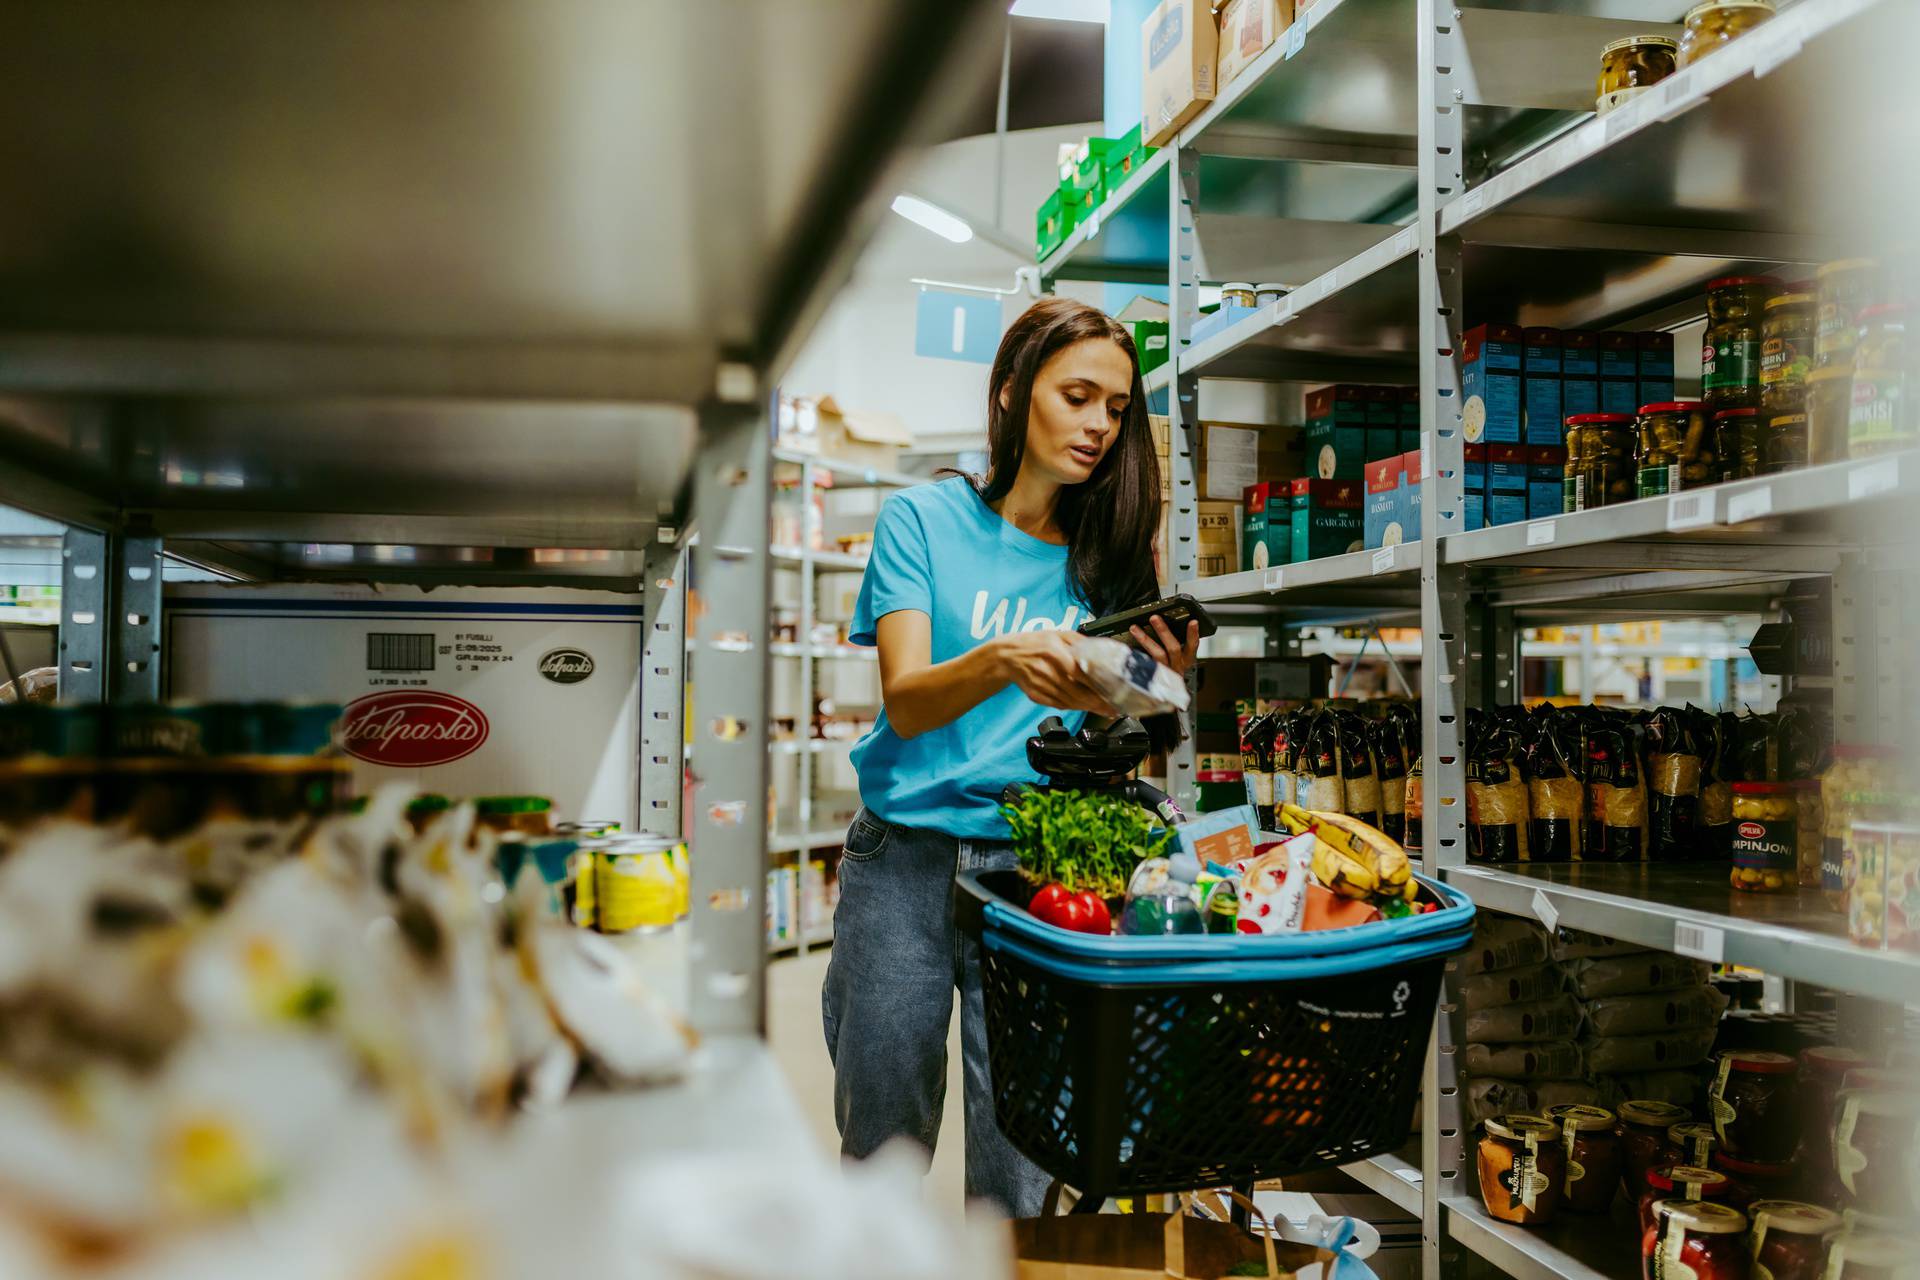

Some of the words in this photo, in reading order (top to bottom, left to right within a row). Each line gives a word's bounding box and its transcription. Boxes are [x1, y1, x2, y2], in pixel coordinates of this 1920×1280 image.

[1291, 25, 1303, 48] 15
[1217, 516, 1229, 525] 20
[1740, 826, 1762, 835] SPILVA
